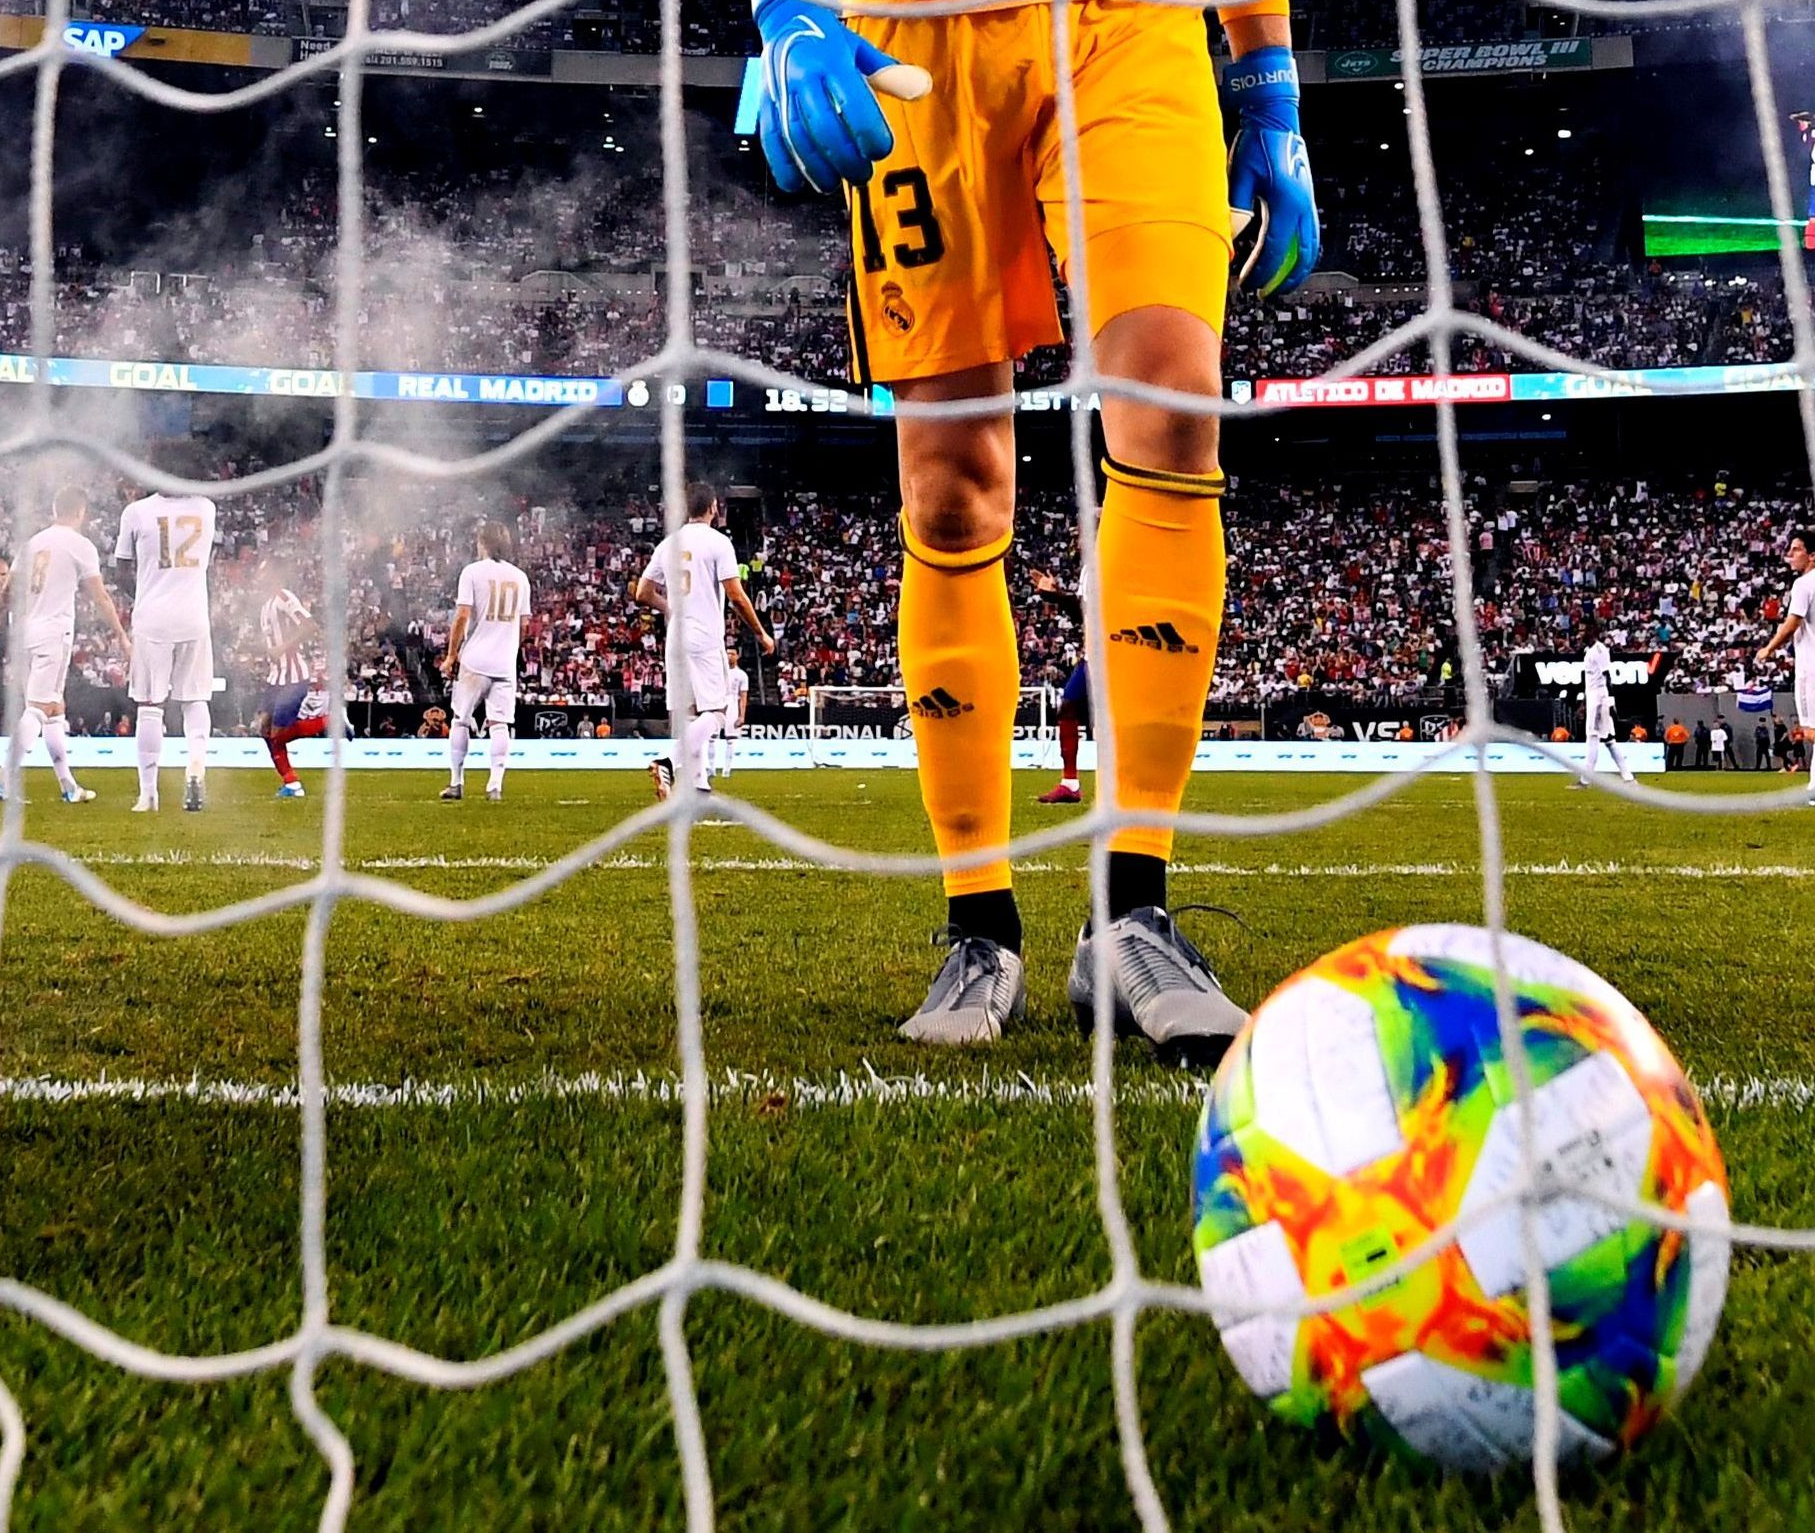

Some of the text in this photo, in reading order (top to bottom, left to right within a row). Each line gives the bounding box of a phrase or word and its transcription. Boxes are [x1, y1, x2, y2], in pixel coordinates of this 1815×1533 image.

[63, 28, 125, 58] SAP
[1390, 40, 1580, 64] SPER BOWL III
[1422, 54, 1548, 71] CHAMPIONS
[1230, 69, 1296, 92] OURTOIS
[859, 166, 945, 274] 13
[109, 361, 197, 391] GOAL
[397, 375, 469, 400] REAL
[479, 379, 598, 404] MADRID
[1374, 380, 1405, 402] DE
[1411, 376, 1507, 401] MADRID
[1565, 370, 1653, 398] GOAL
[156, 515, 203, 569] 12
[486, 579, 519, 622] 10
[1535, 661, 1649, 685] veron
